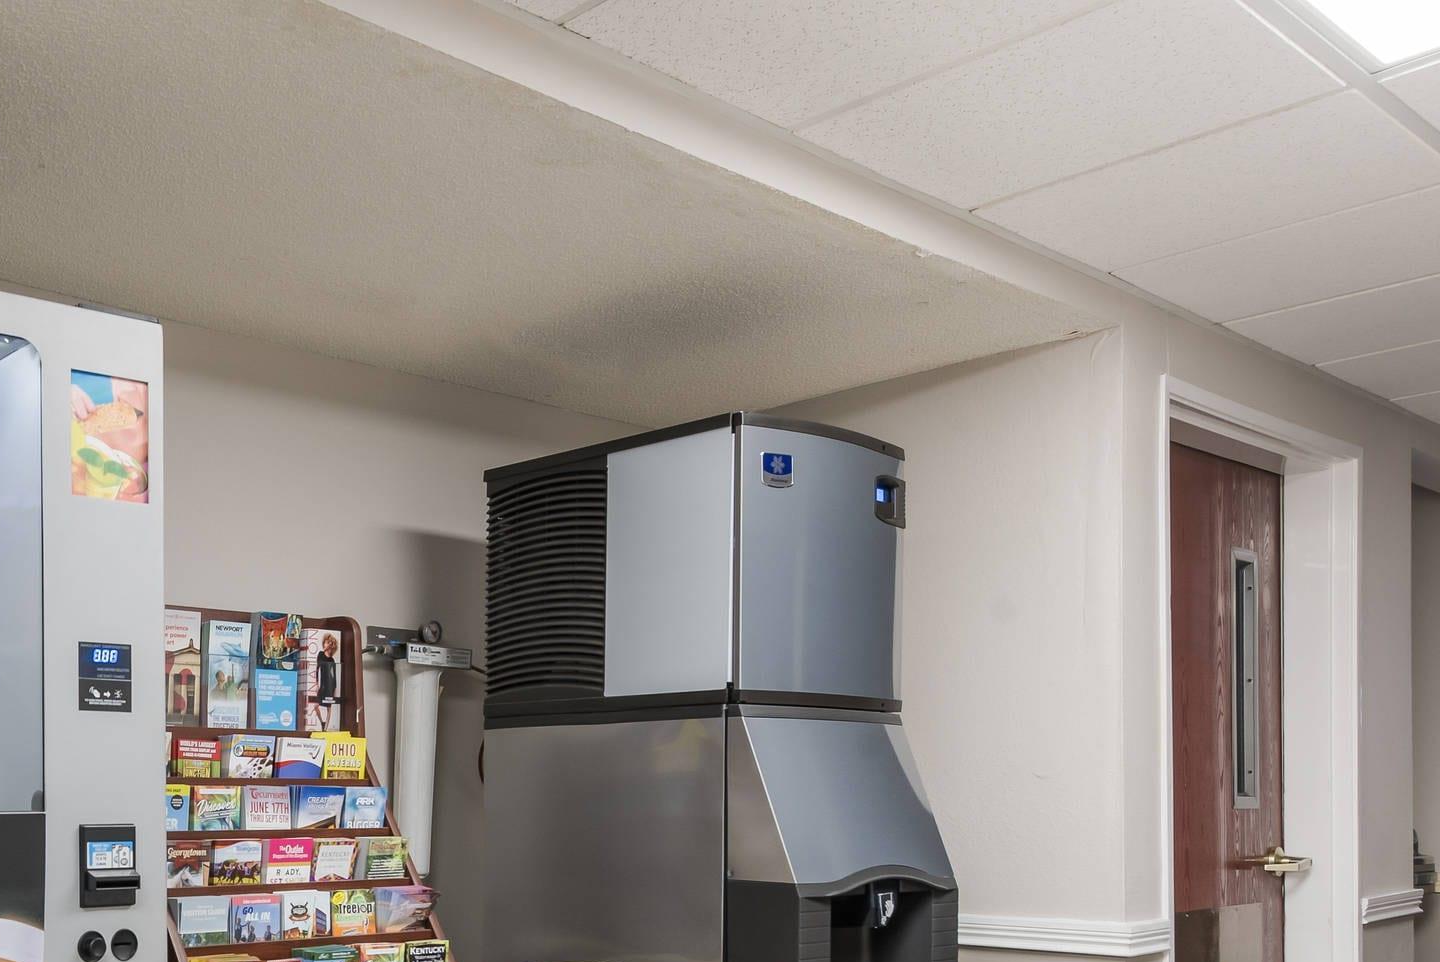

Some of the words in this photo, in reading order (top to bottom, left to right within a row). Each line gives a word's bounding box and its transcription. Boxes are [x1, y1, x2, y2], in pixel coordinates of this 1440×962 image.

[215, 625, 244, 633] NEWPORT
[331, 743, 356, 757] OHIO
[250, 801, 269, 814] JUNE
[271, 802, 289, 815] 17TH
[265, 814, 277, 823] SEPT
[242, 906, 254, 915] GO
[244, 912, 260, 921] ALL
[261, 911, 271, 921] IN
[409, 945, 445, 956] KENTUCKY
